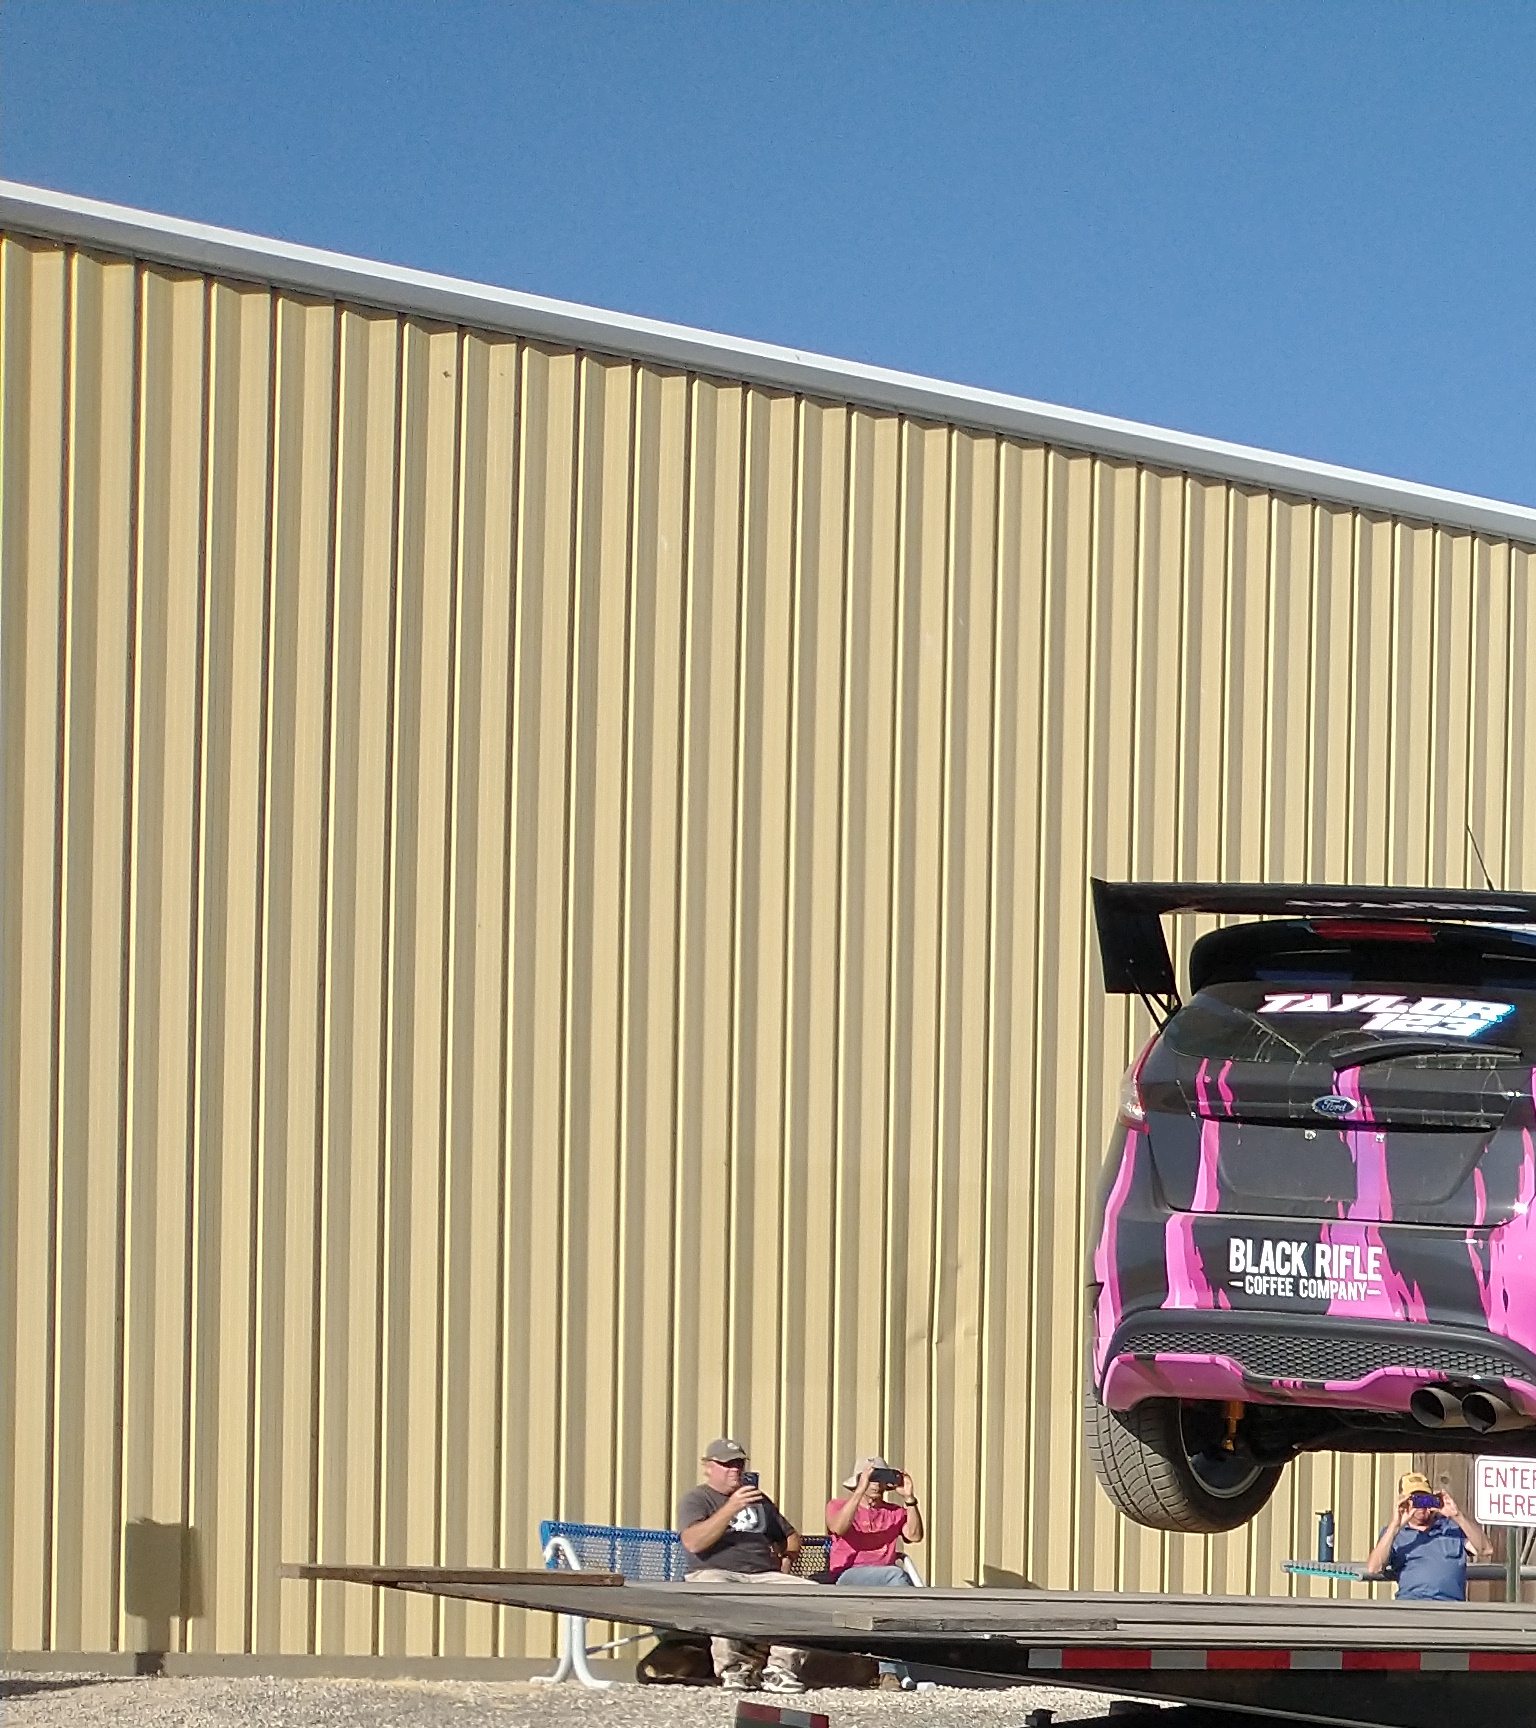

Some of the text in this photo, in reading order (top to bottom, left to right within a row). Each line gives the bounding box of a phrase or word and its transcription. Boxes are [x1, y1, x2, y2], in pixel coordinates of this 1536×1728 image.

[1257, 994, 1515, 1022] TAYLOR
[1360, 1013, 1501, 1037] 123
[1229, 1238, 1383, 1281] BLACK RIFLE
[1245, 1275, 1368, 1302] COFFEE COMPANY
